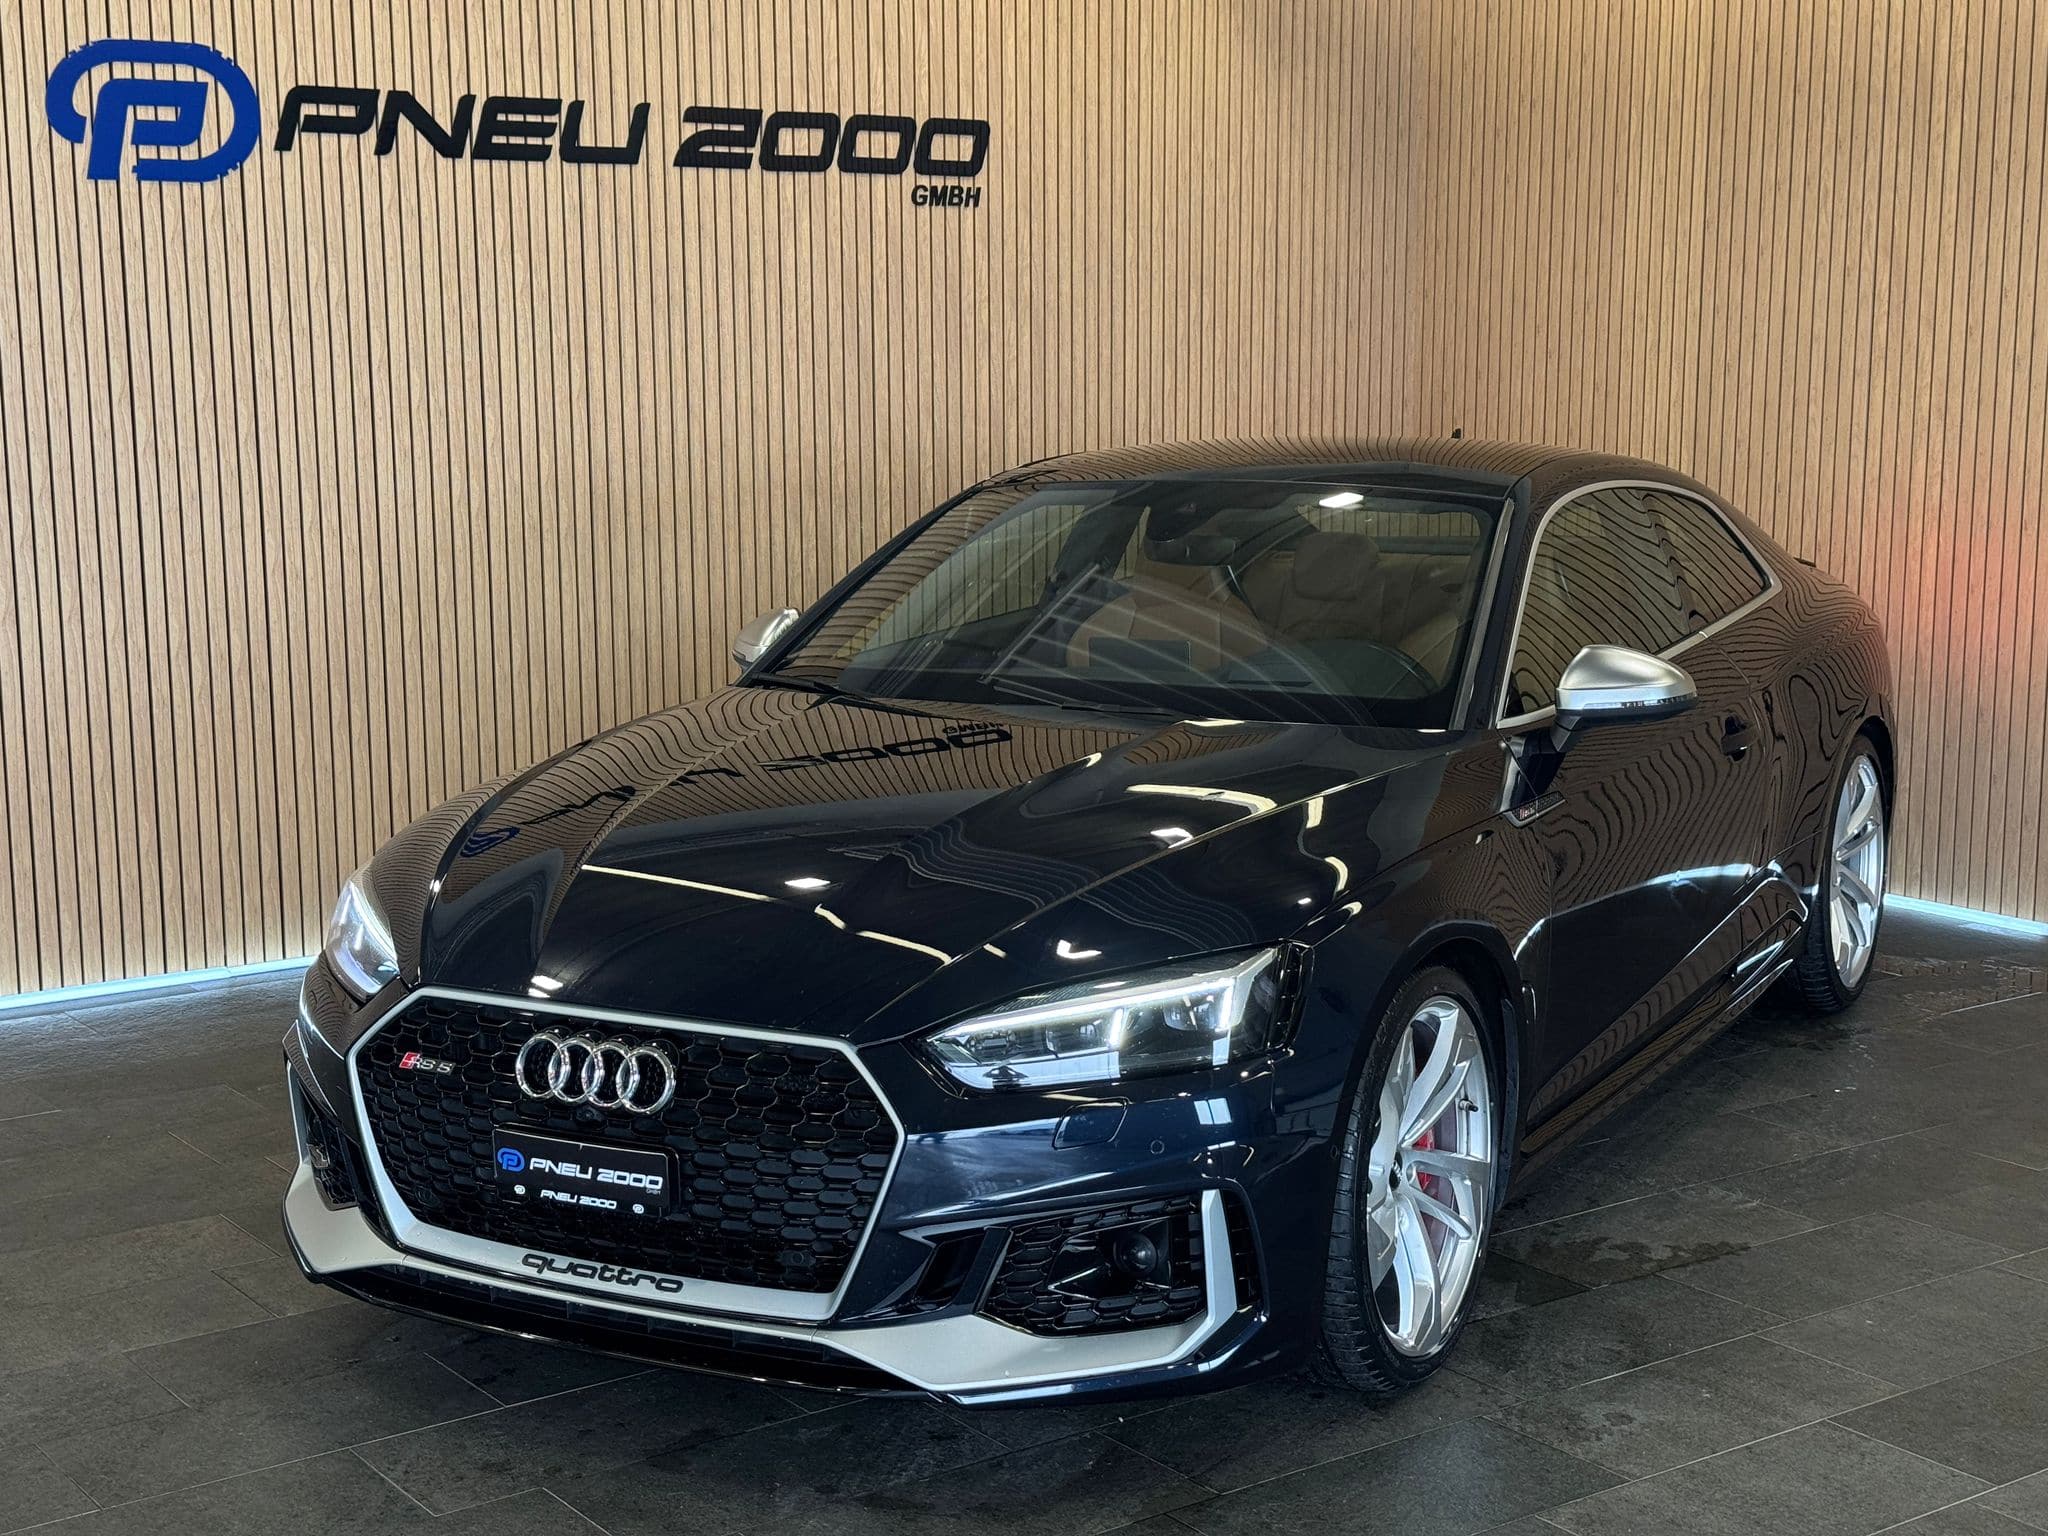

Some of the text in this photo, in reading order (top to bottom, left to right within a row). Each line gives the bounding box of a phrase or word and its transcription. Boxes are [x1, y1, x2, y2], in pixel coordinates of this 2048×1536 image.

[273, 84, 651, 165] PNEU
[672, 105, 991, 178] 2000
[910, 183, 982, 209] GMBH
[529, 1157, 592, 1180] PNEU
[596, 1168, 663, 1190] 2000
[540, 1189, 617, 1210] PNEU 2000
[521, 1253, 684, 1293] quattro
